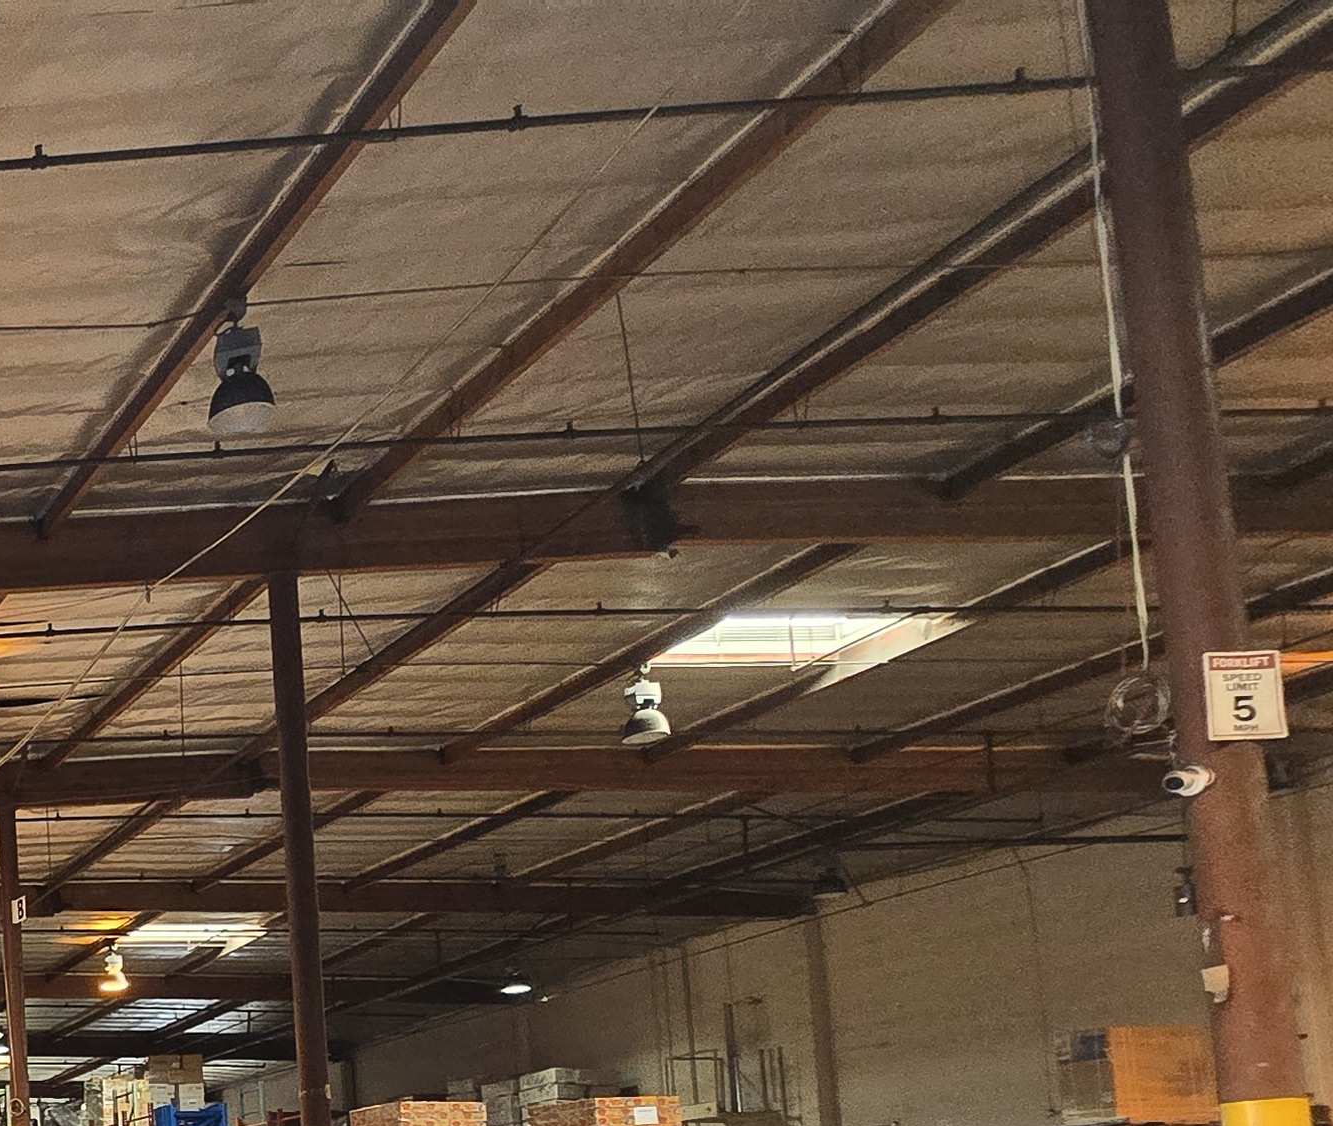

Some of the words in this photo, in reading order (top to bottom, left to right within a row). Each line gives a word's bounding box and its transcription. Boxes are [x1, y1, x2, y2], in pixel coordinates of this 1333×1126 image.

[1212, 656, 1270, 668] FORKLIFT
[1222, 673, 1262, 682] SPEED
[1226, 682, 1259, 691] LIMIT
[1232, 695, 1256, 722] 5
[1233, 724, 1259, 732] MPH
[17, 899, 24, 920] B
